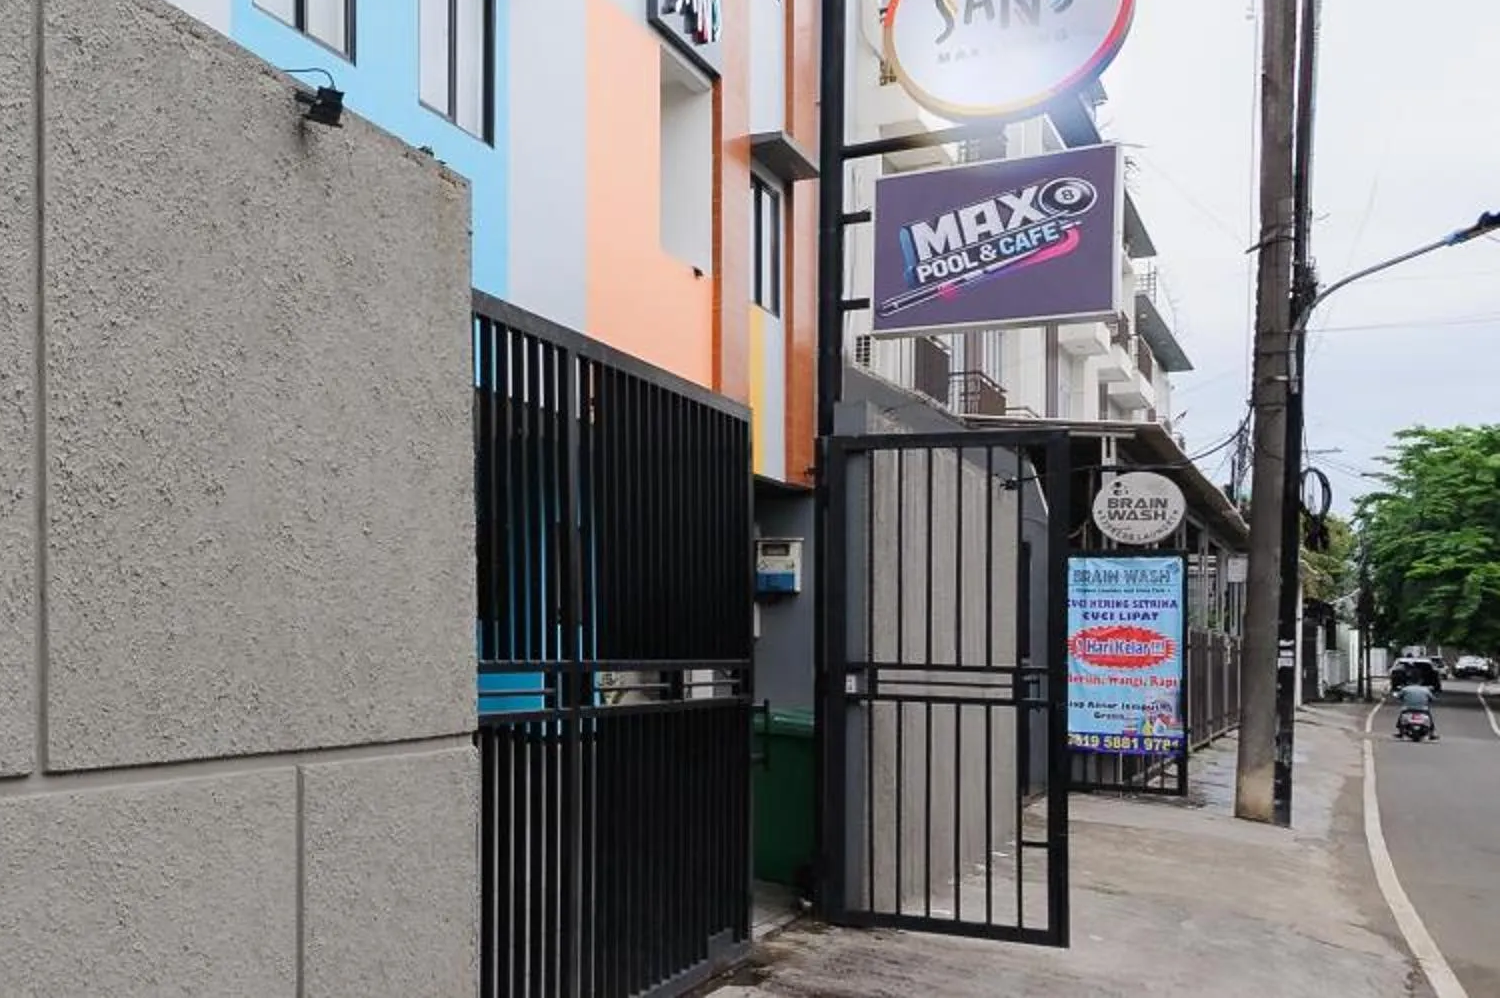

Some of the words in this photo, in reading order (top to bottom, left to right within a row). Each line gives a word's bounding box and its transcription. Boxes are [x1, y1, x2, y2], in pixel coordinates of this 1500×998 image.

[910, 185, 1046, 261] MAX
[915, 251, 978, 283] POOL
[980, 244, 997, 261] &
[1000, 222, 1060, 254] CAFE
[1107, 497, 1169, 509] BRAIN
[1107, 509, 1167, 521] WASH
[1073, 569, 1119, 583] BRAIN
[1124, 570, 1171, 583] WASH
[1082, 612, 1115, 621] CUCI
[1119, 612, 1159, 621] LIPAT
